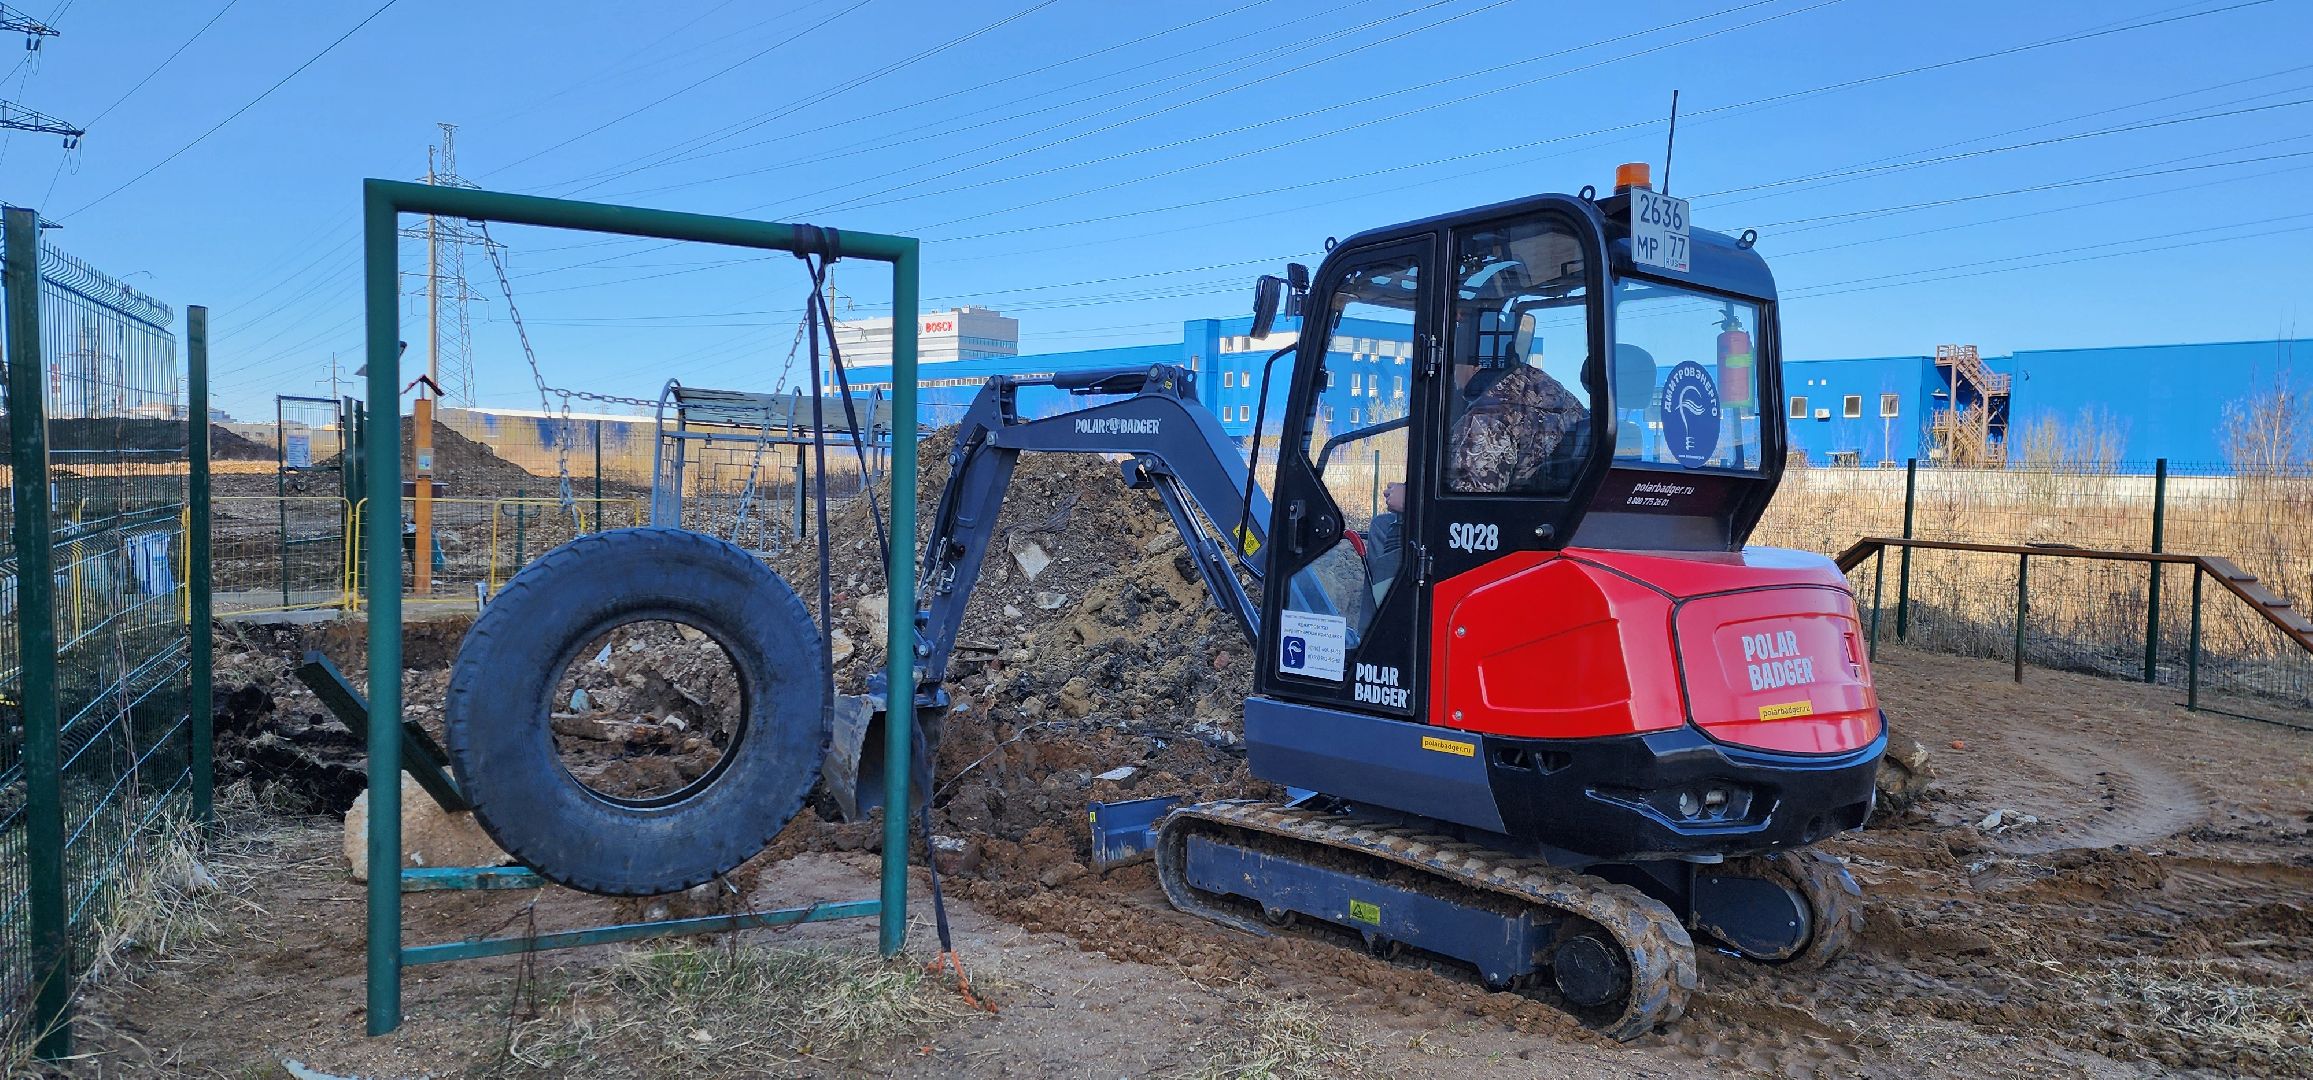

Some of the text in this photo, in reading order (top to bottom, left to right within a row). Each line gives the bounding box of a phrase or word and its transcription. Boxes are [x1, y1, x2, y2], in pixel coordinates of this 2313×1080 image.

[1641, 194, 1682, 230] 2636
[1669, 235, 1686, 259] 77
[926, 321, 953, 333] BOSCH
[1664, 366, 1718, 417] ДМИТРОВЭНЕРГО
[1075, 418, 1160, 434] POLAR BADGER
[1632, 481, 1695, 496] polarbadger.ru
[1449, 523, 1499, 553] SQ28
[1742, 630, 1800, 661] POLAR
[1356, 662, 1399, 686] POLAR
[1748, 658, 1815, 691] BADGER
[1354, 683, 1407, 708] BADGER
[1762, 704, 1811, 718] polarbadger.ru
[1424, 739, 1471, 754] polarbadger.ru
